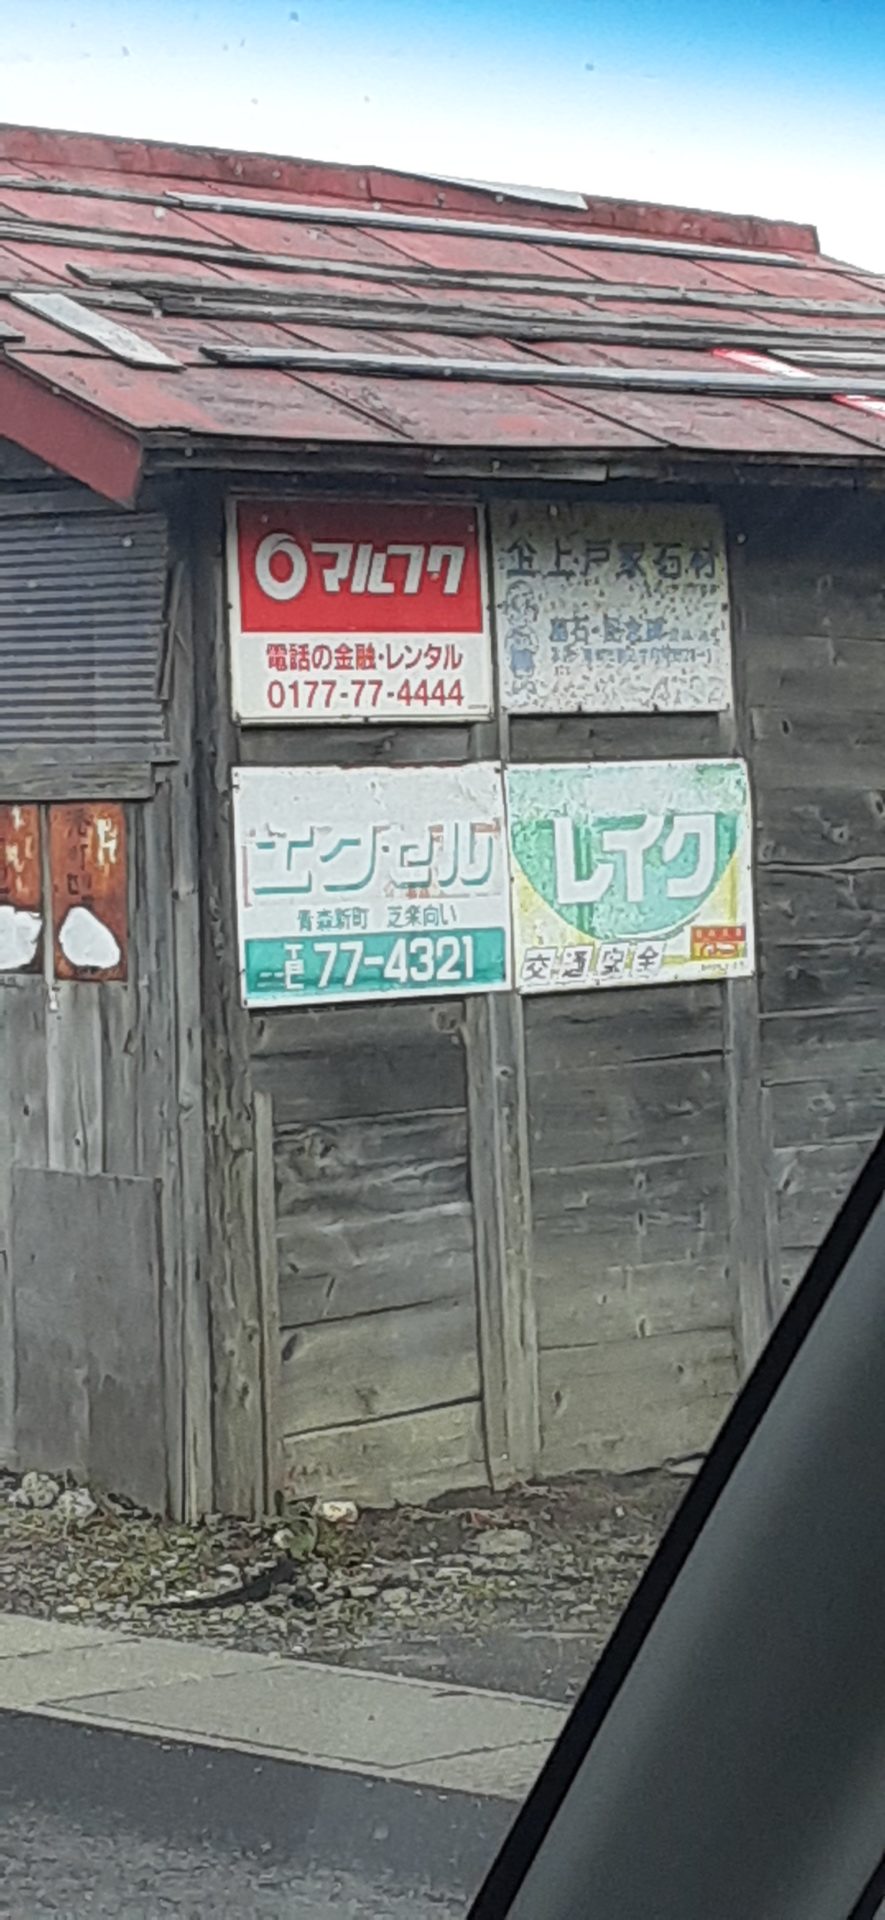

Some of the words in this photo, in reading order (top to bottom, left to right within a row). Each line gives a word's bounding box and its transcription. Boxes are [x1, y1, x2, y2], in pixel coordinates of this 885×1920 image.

[312, 541, 466, 595] マルフク
[265, 643, 463, 672] 電話の金融・レンタル
[267, 679, 464, 709] 0177-77-4444
[554, 813, 716, 904] レイク
[313, 935, 475, 989] 77-4321
